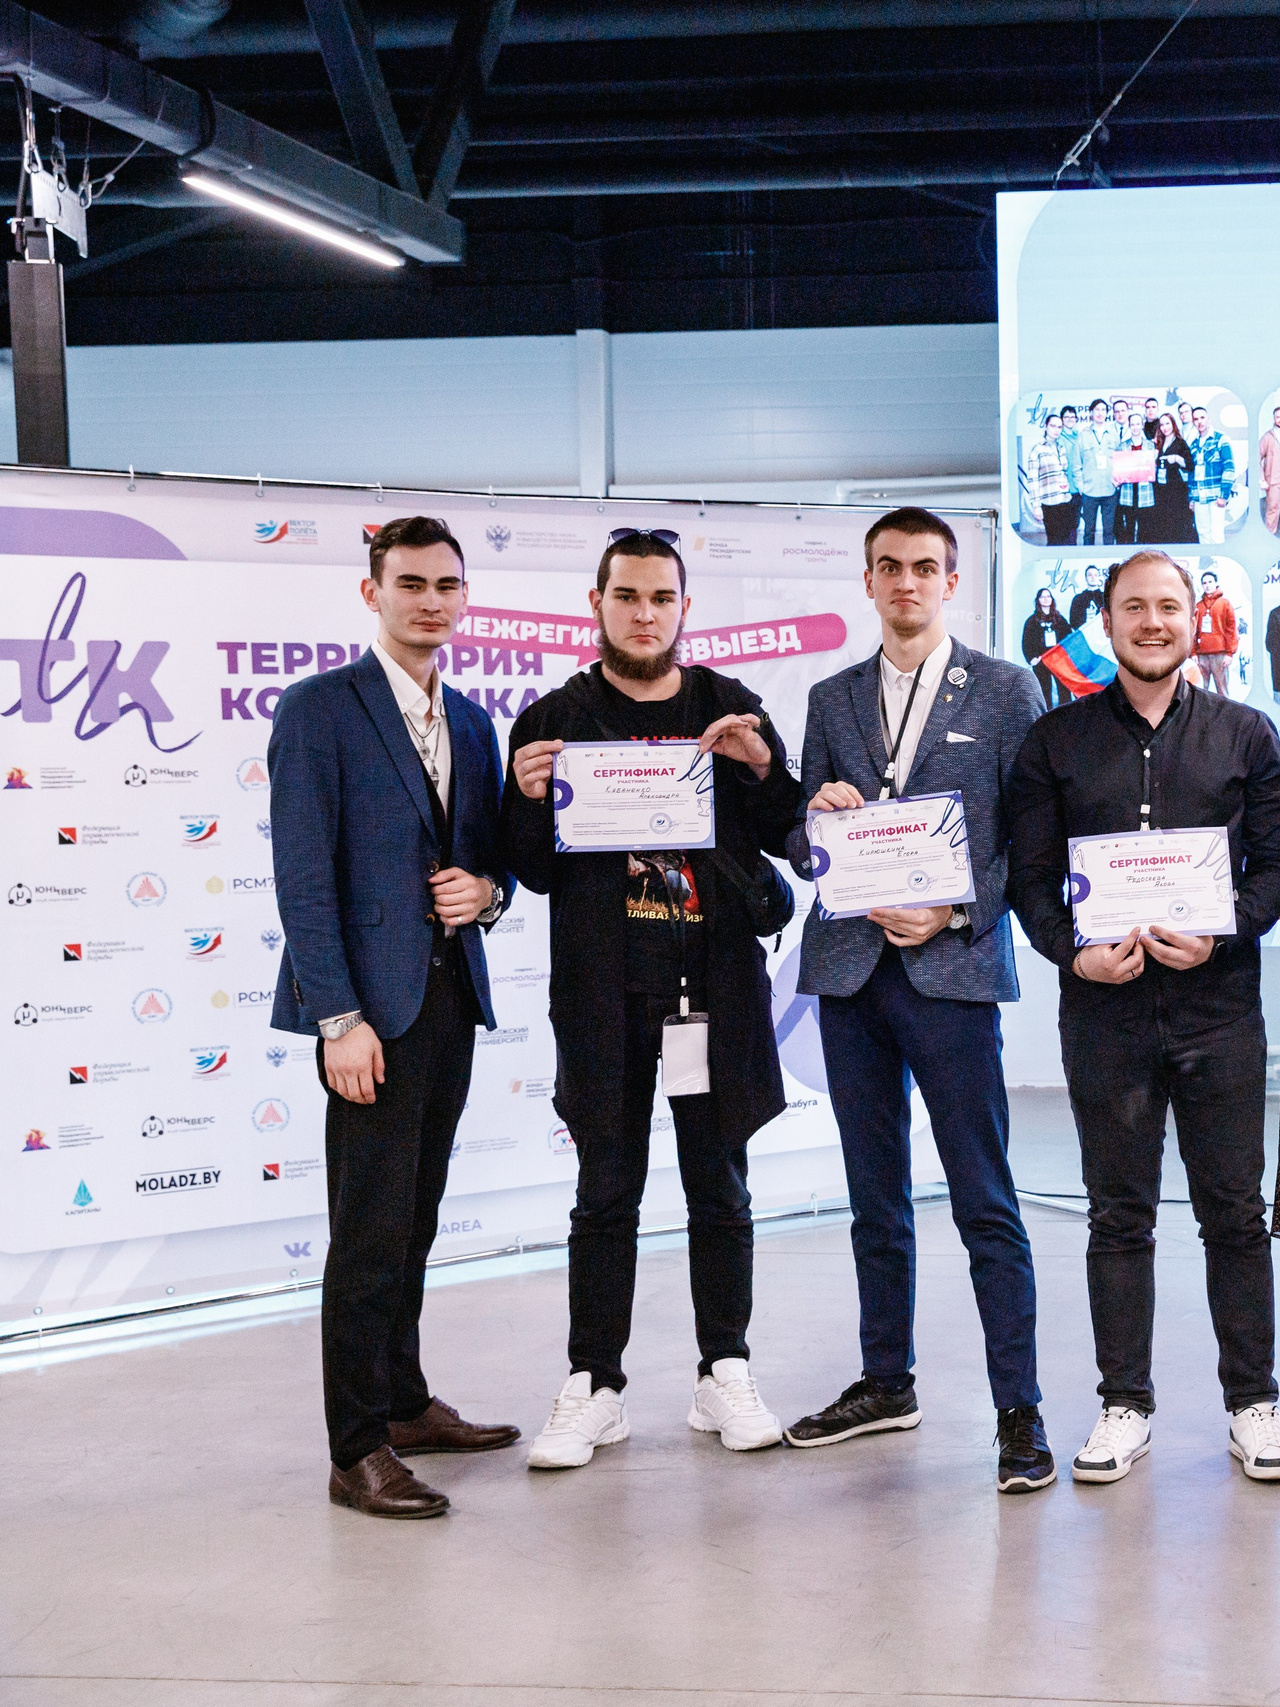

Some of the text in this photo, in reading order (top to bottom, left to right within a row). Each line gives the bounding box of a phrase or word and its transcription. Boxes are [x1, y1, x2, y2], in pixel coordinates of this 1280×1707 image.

[456, 615, 600, 648] МЕЖРЕГИ
[593, 767, 676, 778] СЕРТИФИКАТ
[847, 822, 928, 841] СЕРТИФИКАТ
[1109, 854, 1193, 869] СЕРТИФИКАТ
[786, 1098, 819, 1110] лабуга
[135, 1170, 222, 1193] MOLADZ.BY
